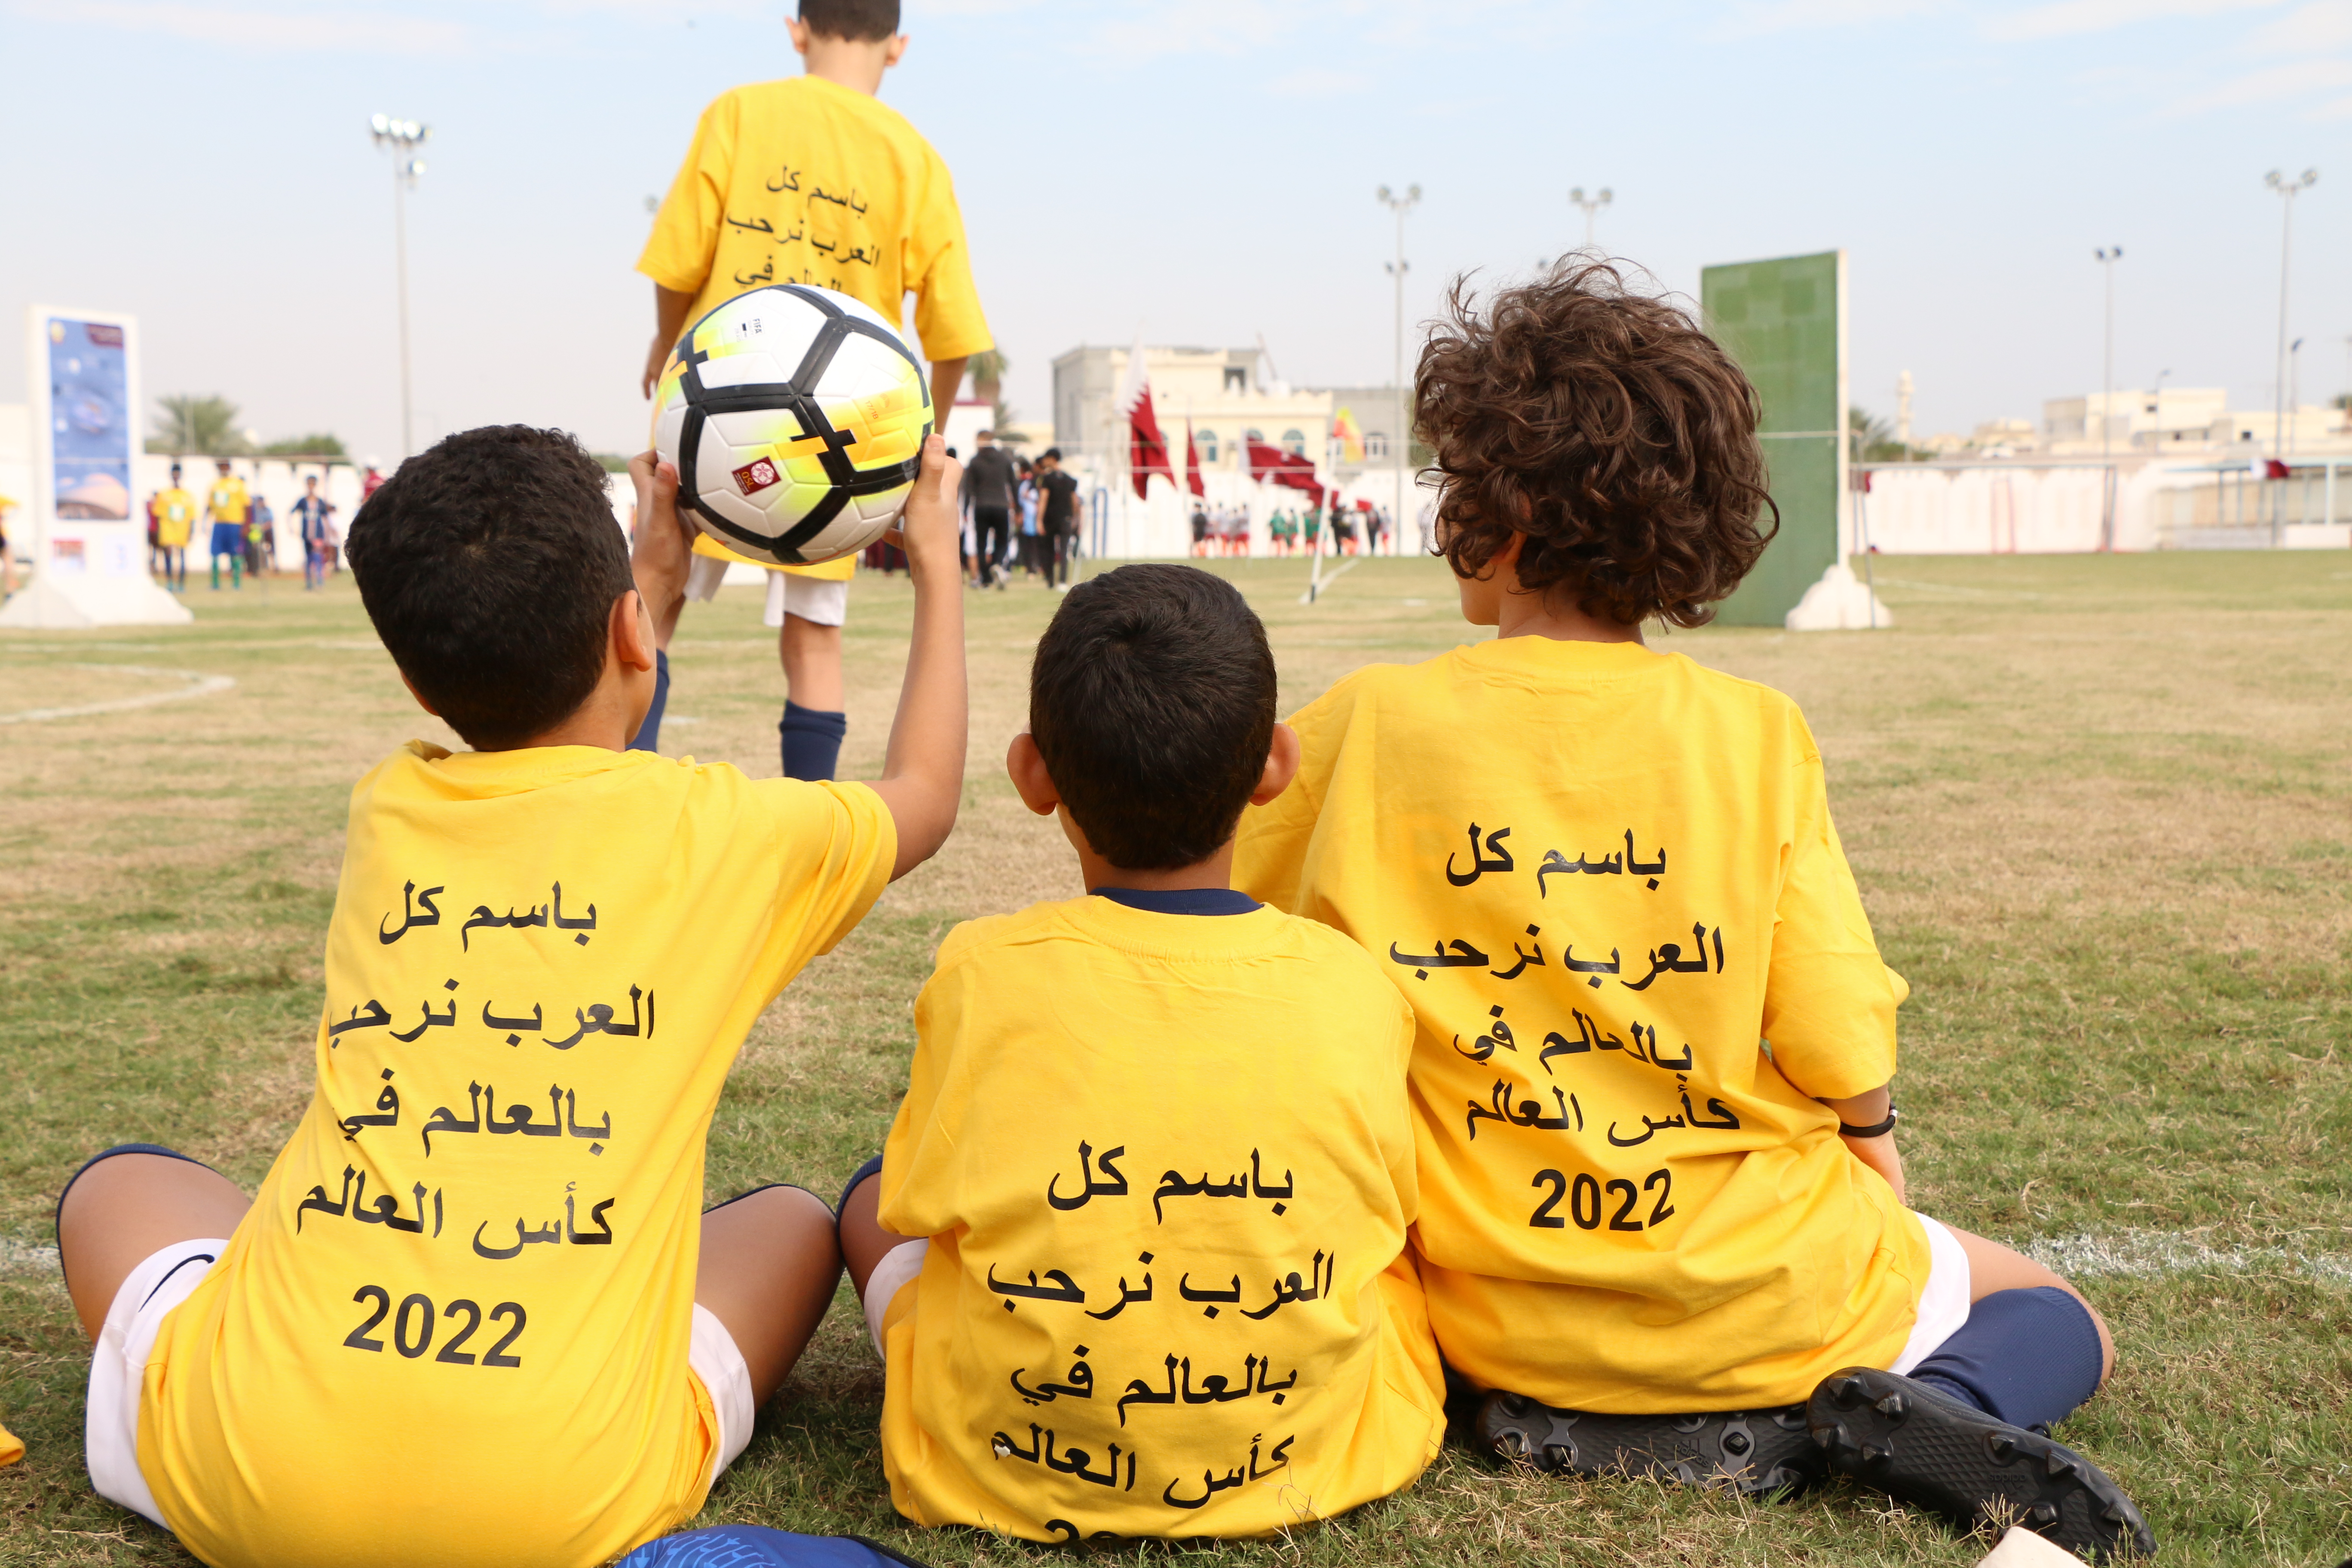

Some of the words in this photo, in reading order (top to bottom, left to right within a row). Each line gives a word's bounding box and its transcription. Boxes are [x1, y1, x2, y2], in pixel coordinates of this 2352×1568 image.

[766, 165, 800, 192] كل
[807, 187, 867, 220] باسم
[726, 212, 803, 244] نرحب
[810, 232, 880, 268] العرب
[734, 254, 773, 288] في
[753, 318, 762, 334] FIFA
[865, 400, 879, 419] 17/18
[1446, 822, 1513, 886] كل
[1537, 828, 1666, 900] باسم
[379, 879, 444, 945] كل
[462, 880, 596, 953] باسم
[1390, 923, 1546, 980] نرحب
[1564, 922, 1724, 991] العرب
[328, 978, 459, 1049] نرحب
[482, 983, 654, 1050] العرب
[1453, 1004, 1517, 1066] في
[338, 1068, 399, 1143] في
[422, 1080, 610, 1158] بالعالم
[1467, 1078, 1583, 1141] العالم
[1608, 1081, 1740, 1147] كأس
[297, 1164, 443, 1238] العالم
[1047, 1139, 1128, 1210] كل
[1153, 1147, 1292, 1225] باسم
[1529, 1168, 1675, 1231] 2022
[473, 1181, 615, 1259] كأس
[987, 1251, 1154, 1320] نرحب
[1179, 1249, 1334, 1320] العرب
[343, 1285, 527, 1368] 2022
[1011, 1344, 1093, 1406] في
[1117, 1353, 1297, 1428] بالعالم
[991, 1422, 1136, 1491] العالم
[1163, 1433, 1294, 1509] كأس
[1675, 1444, 1709, 1467] adidas
[1988, 1473, 2026, 1482] adidas
